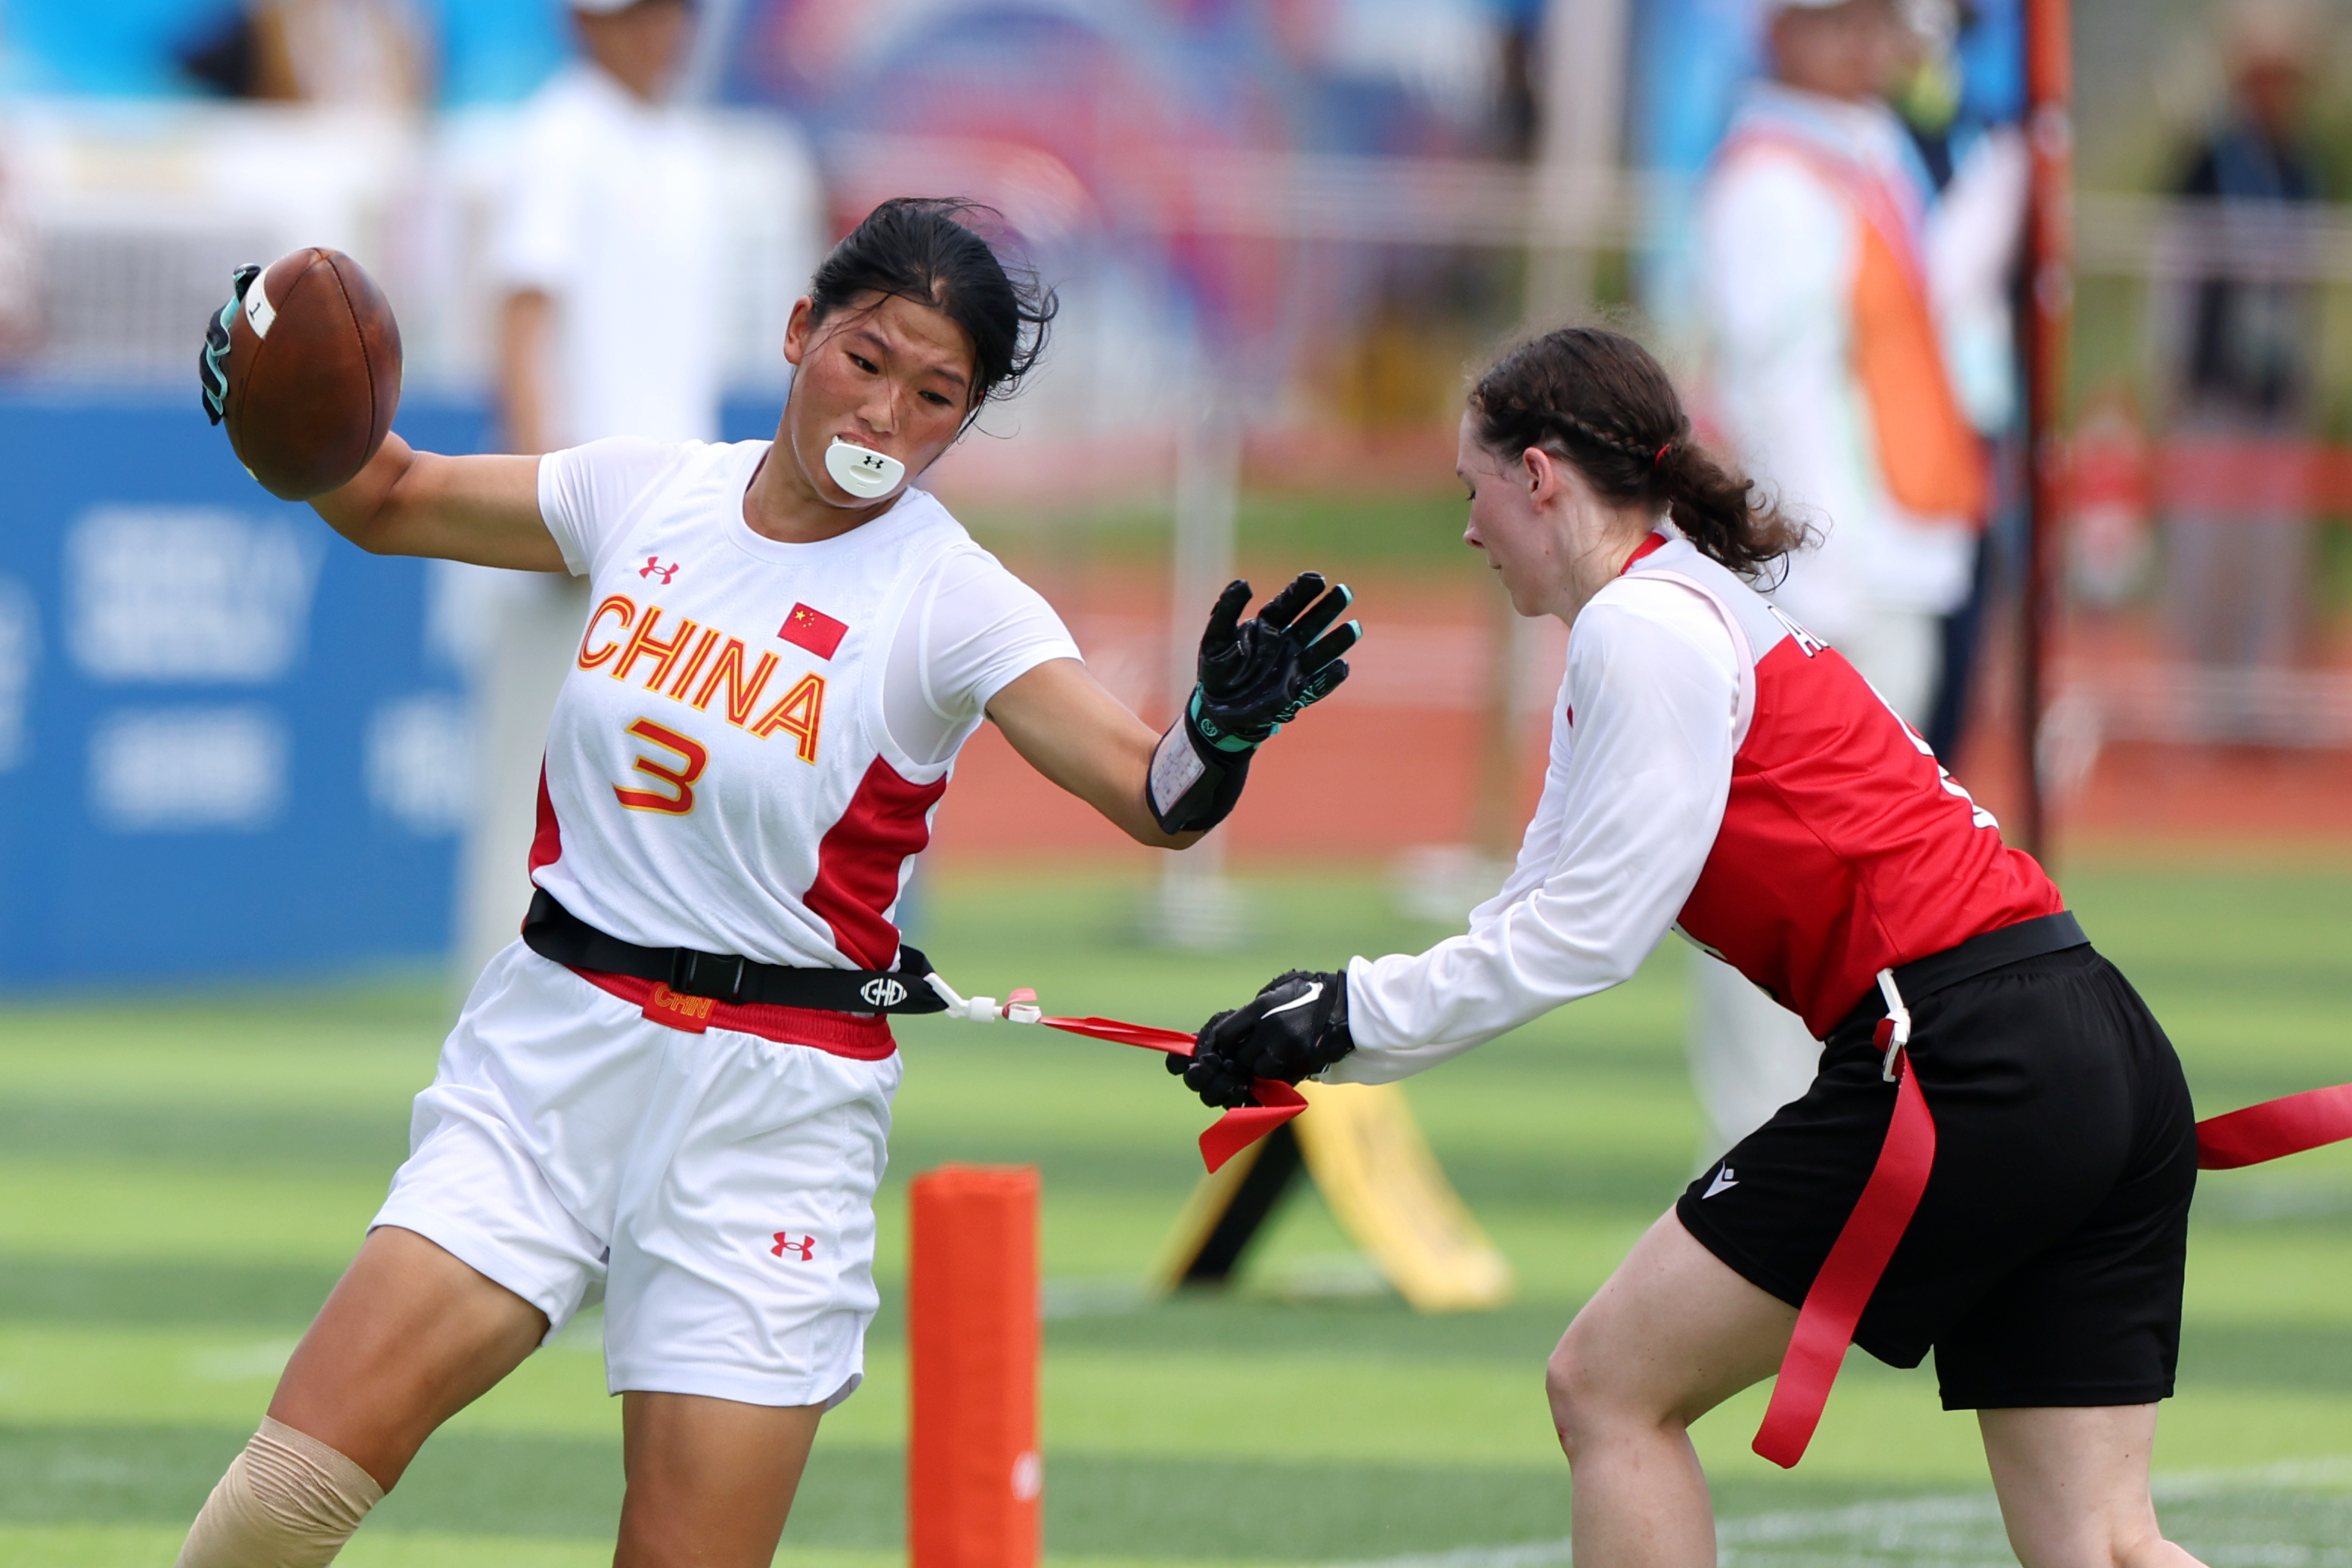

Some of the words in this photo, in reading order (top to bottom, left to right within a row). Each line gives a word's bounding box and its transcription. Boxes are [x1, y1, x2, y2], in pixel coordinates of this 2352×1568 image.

[248, 302, 261, 321] 1
[577, 593, 827, 766] CHINA
[612, 716, 710, 817] 3
